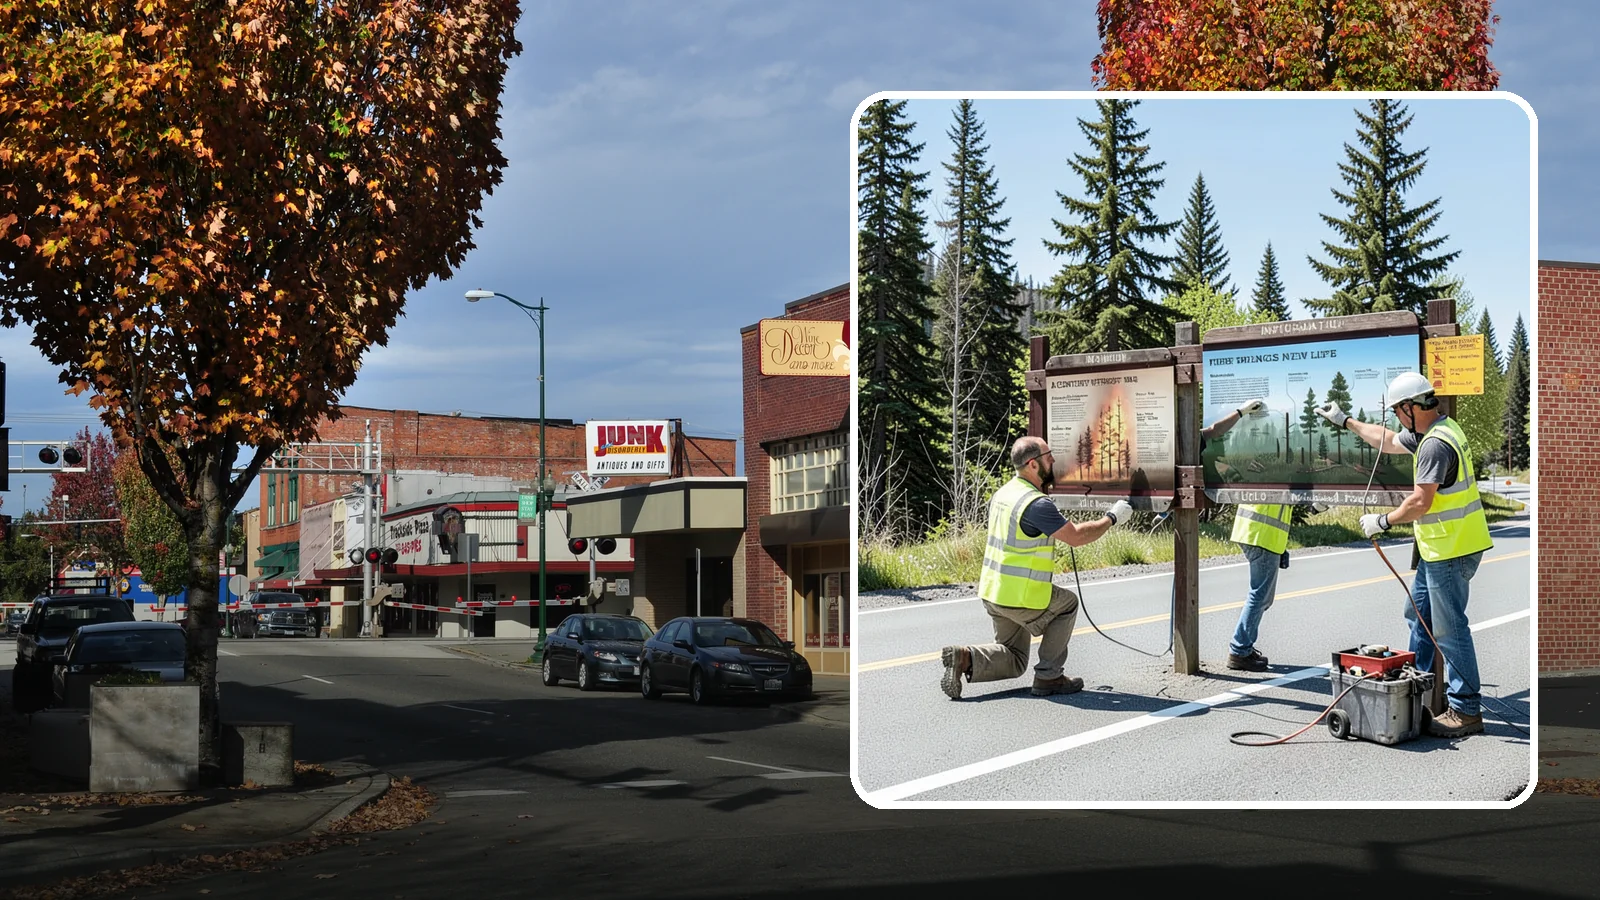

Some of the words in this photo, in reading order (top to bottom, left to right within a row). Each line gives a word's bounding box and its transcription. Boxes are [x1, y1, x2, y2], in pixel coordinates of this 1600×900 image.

[596, 425, 665, 457] JUNK
[608, 446, 645, 454] DISORDERLY
[597, 461, 628, 470] ANTIQUES
[631, 461, 643, 470] AND
[647, 460, 665, 469] GIFTS
[390, 521, 413, 540] Trackside
[414, 519, 429, 535] Pizza
